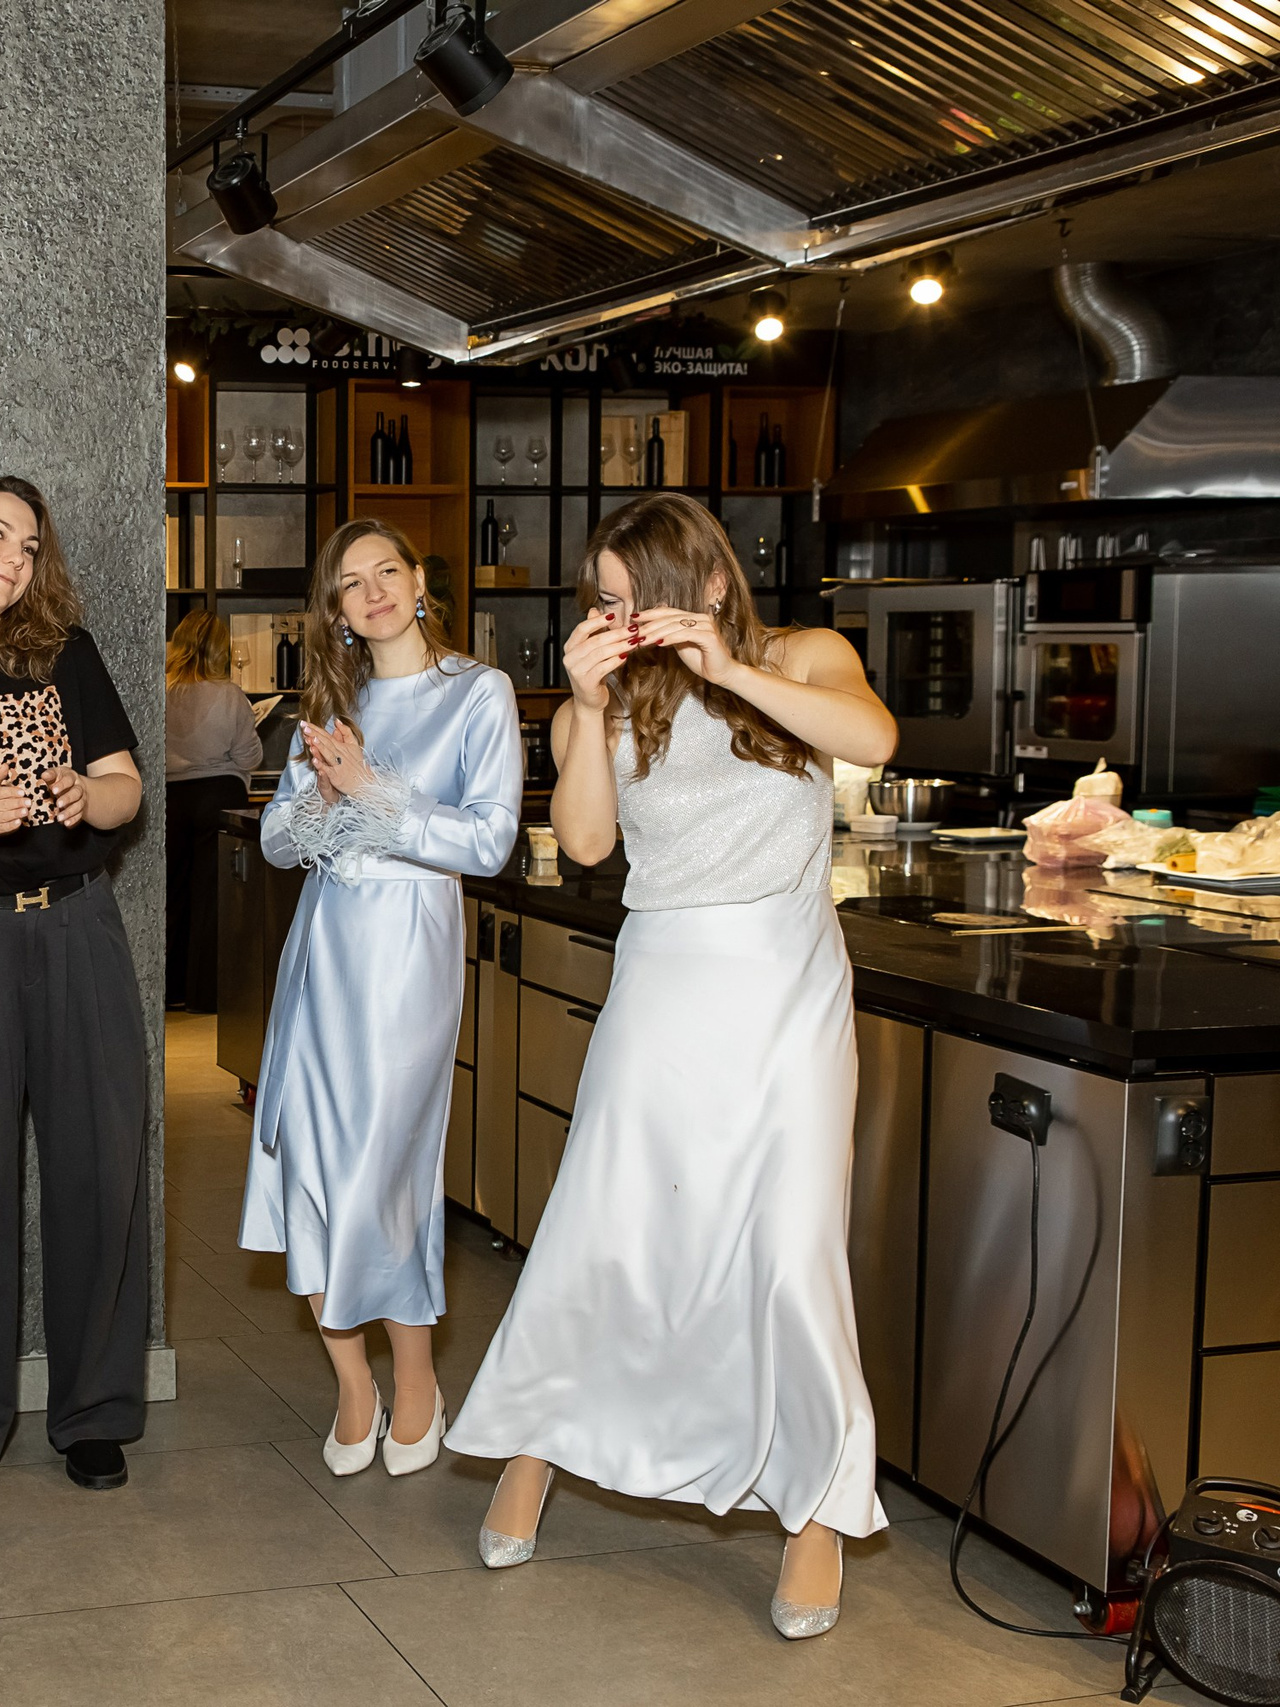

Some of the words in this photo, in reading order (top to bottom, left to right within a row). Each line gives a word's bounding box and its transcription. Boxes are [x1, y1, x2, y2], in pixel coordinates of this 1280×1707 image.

[653, 345, 714, 361] ЛУЧШАЯ
[311, 359, 397, 370] FOODSERV
[653, 360, 748, 378] ЭКО-ЗАЩИТА!
